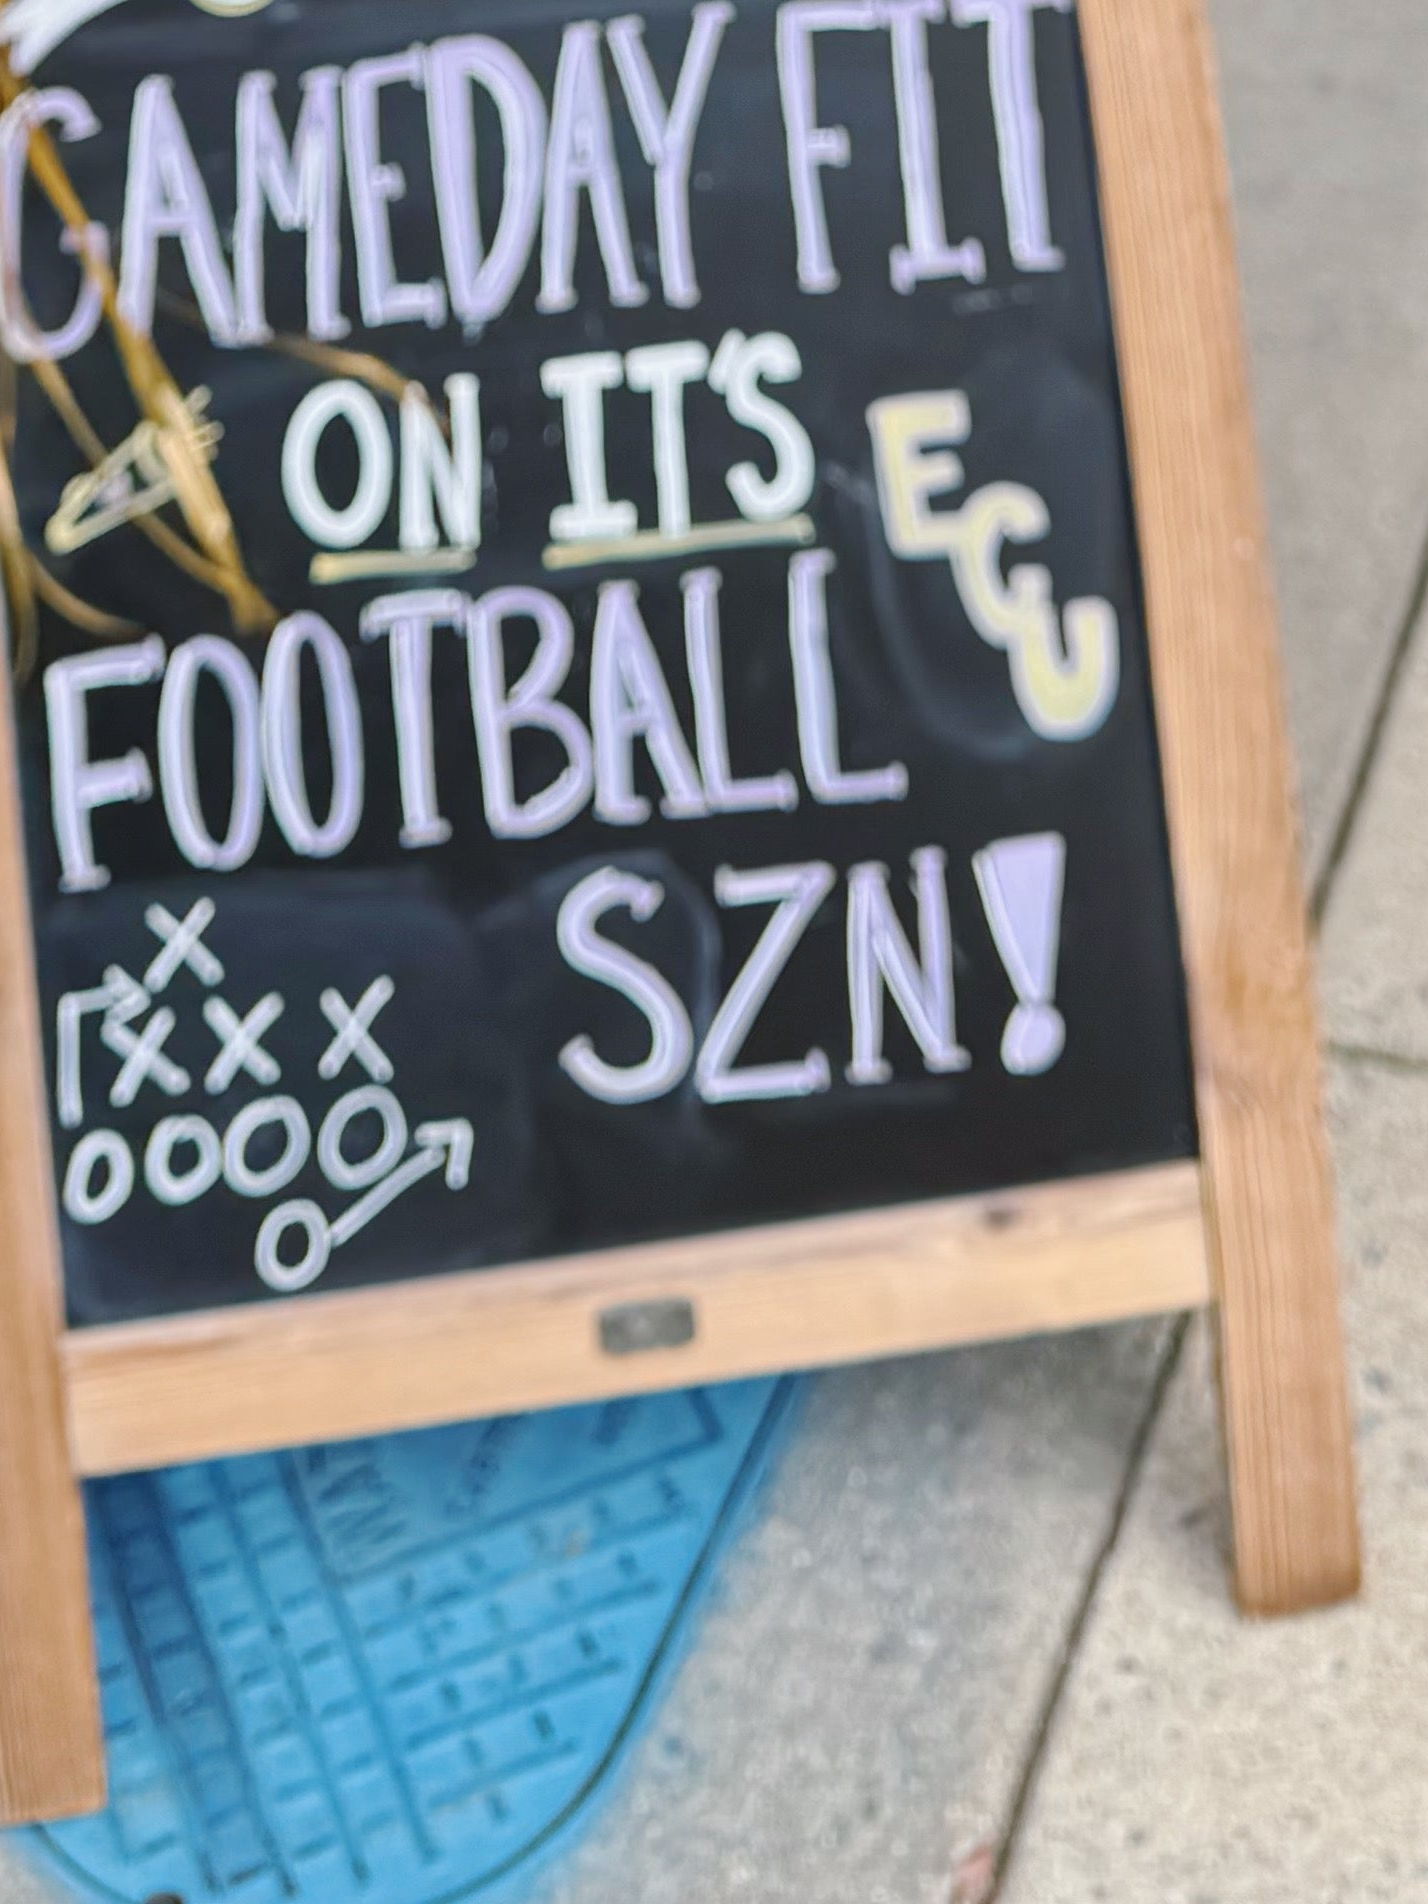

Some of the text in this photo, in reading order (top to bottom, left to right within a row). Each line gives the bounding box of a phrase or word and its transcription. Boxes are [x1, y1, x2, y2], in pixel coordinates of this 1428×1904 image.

[280, 328, 818, 552] ON IT'S
[41, 548, 912, 894] FOOTBALL
[557, 831, 1069, 1106] SZN!
